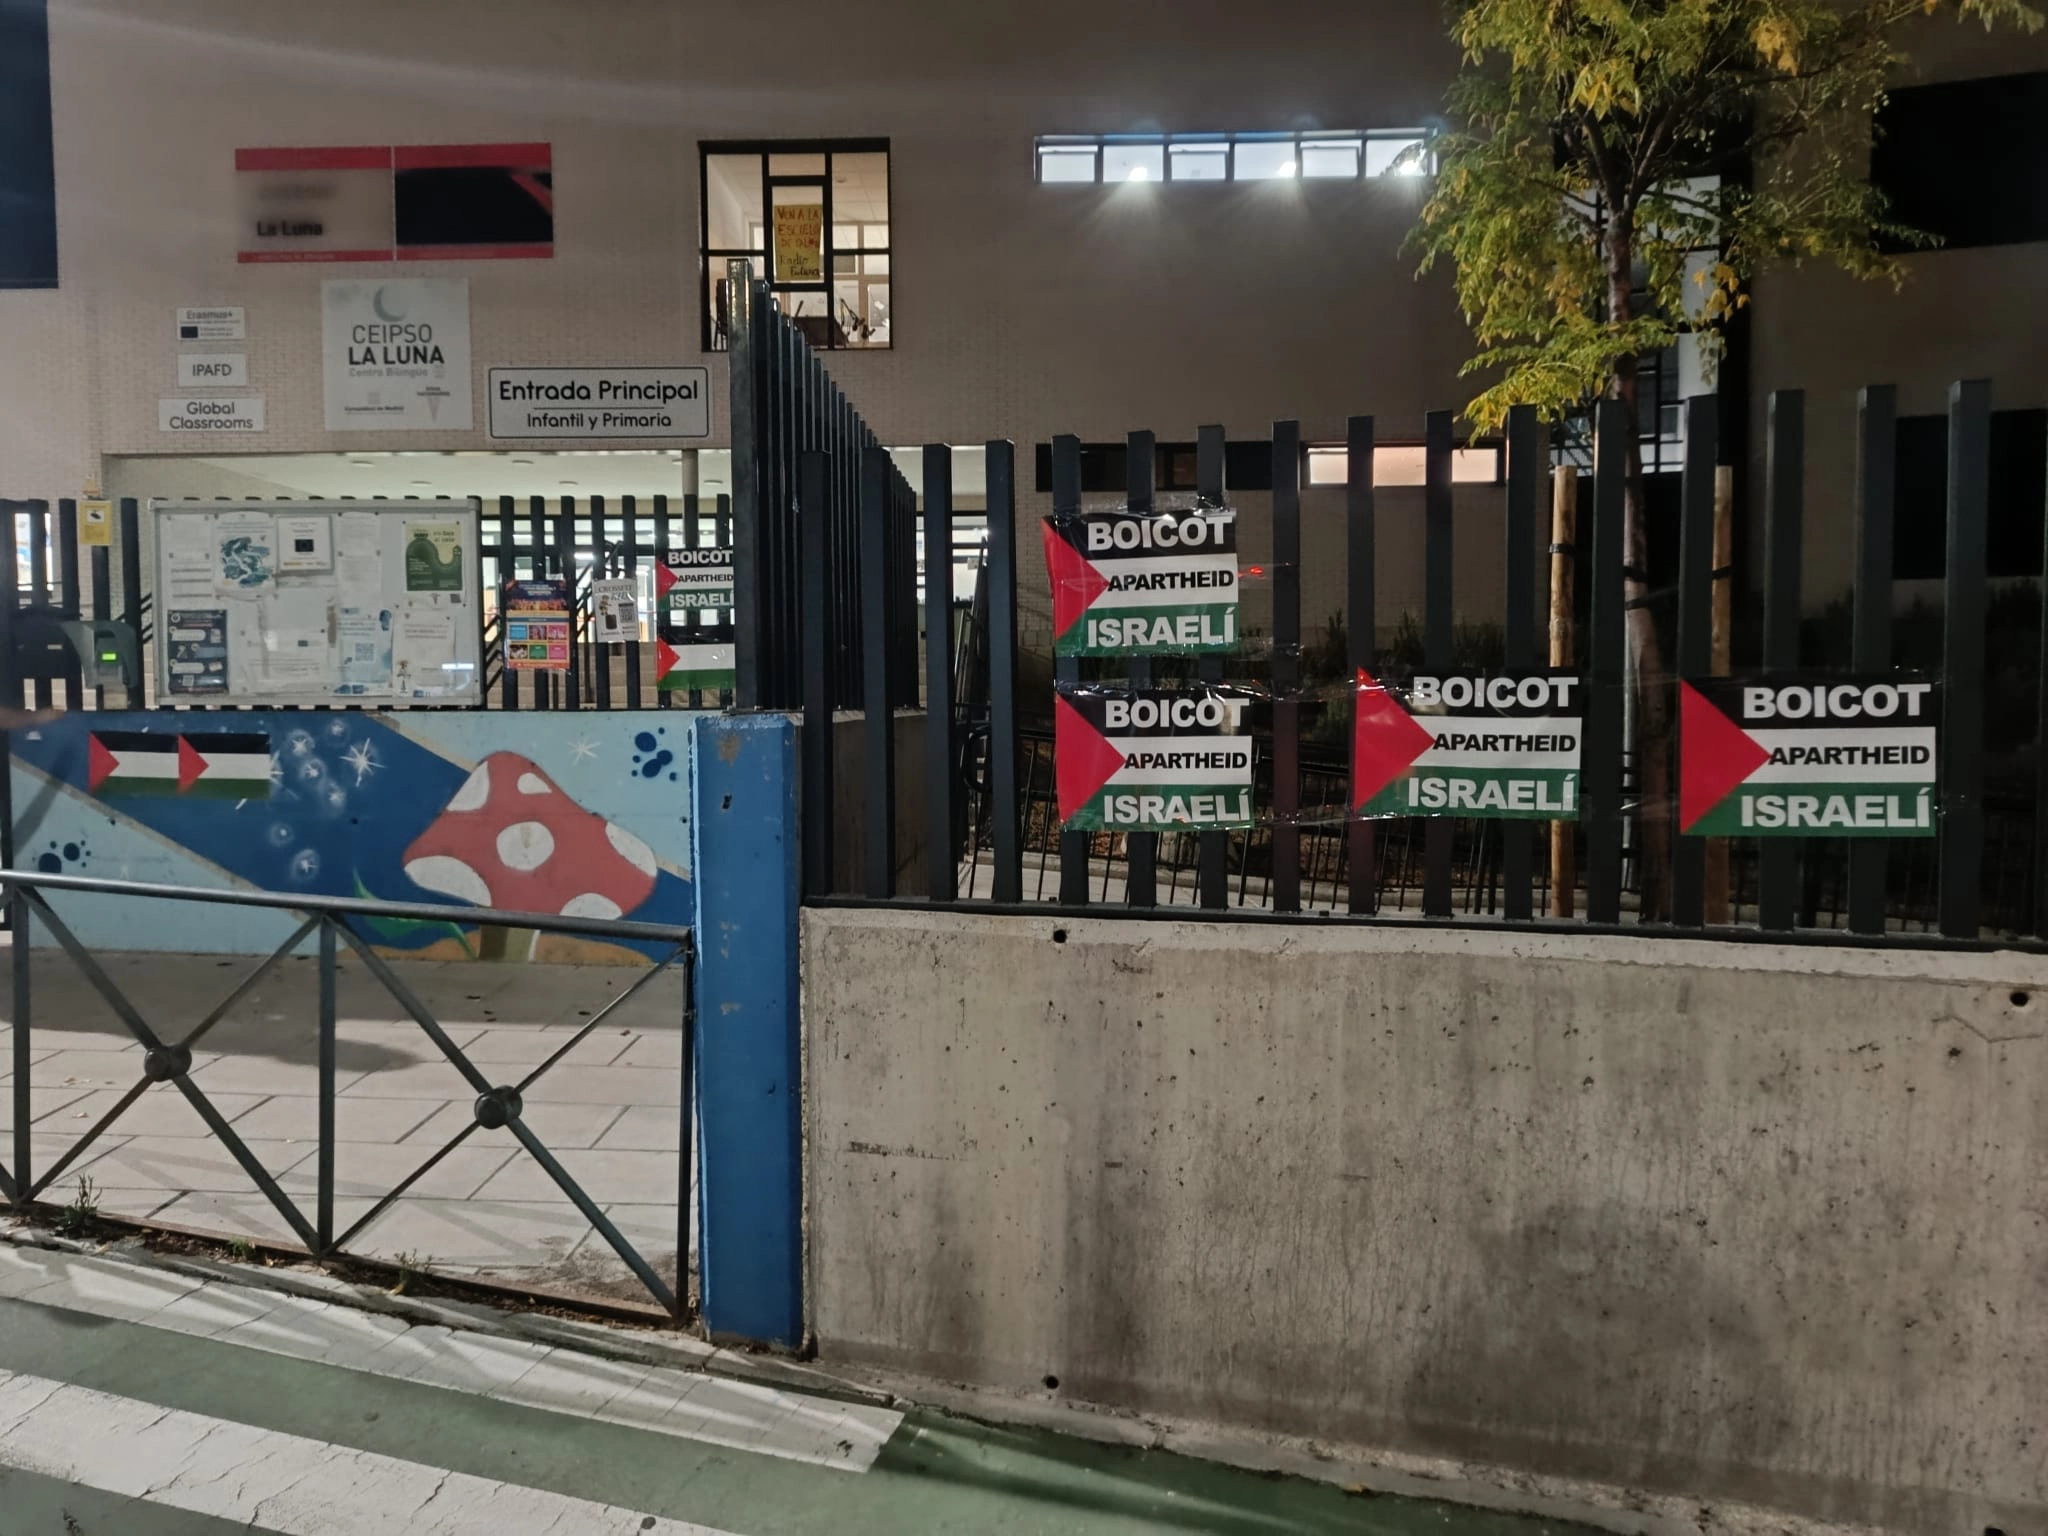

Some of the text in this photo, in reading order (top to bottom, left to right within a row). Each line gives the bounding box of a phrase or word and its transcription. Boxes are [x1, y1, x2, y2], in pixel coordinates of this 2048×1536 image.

[352, 323, 433, 345] CEIPSO
[348, 345, 445, 366] LA LUNA
[192, 363, 232, 377] IPAFD
[499, 379, 698, 404] Entrada Principal
[186, 401, 235, 415] Global
[169, 416, 254, 430] Classrooms
[527, 412, 672, 431] Infantil y Primaria
[1087, 515, 1233, 551] BOICOT
[667, 549, 734, 566] BOICOT
[677, 573, 734, 583] APARTHEID
[1107, 570, 1234, 592] APARTHEID
[1087, 608, 1235, 648] ISRAELÍ
[1413, 675, 1579, 709] BOICOT
[1743, 683, 1932, 720] BOICOT
[1106, 698, 1250, 728] BOICOT
[1433, 733, 1577, 753] APARTHEID
[1124, 752, 1248, 769] APARTHEID
[1768, 746, 1930, 766] APARTHEID
[1408, 774, 1577, 813] ISRAELÍ
[1104, 789, 1250, 823] ISRAELÍ
[1742, 787, 1931, 828] ISRAELÍ
